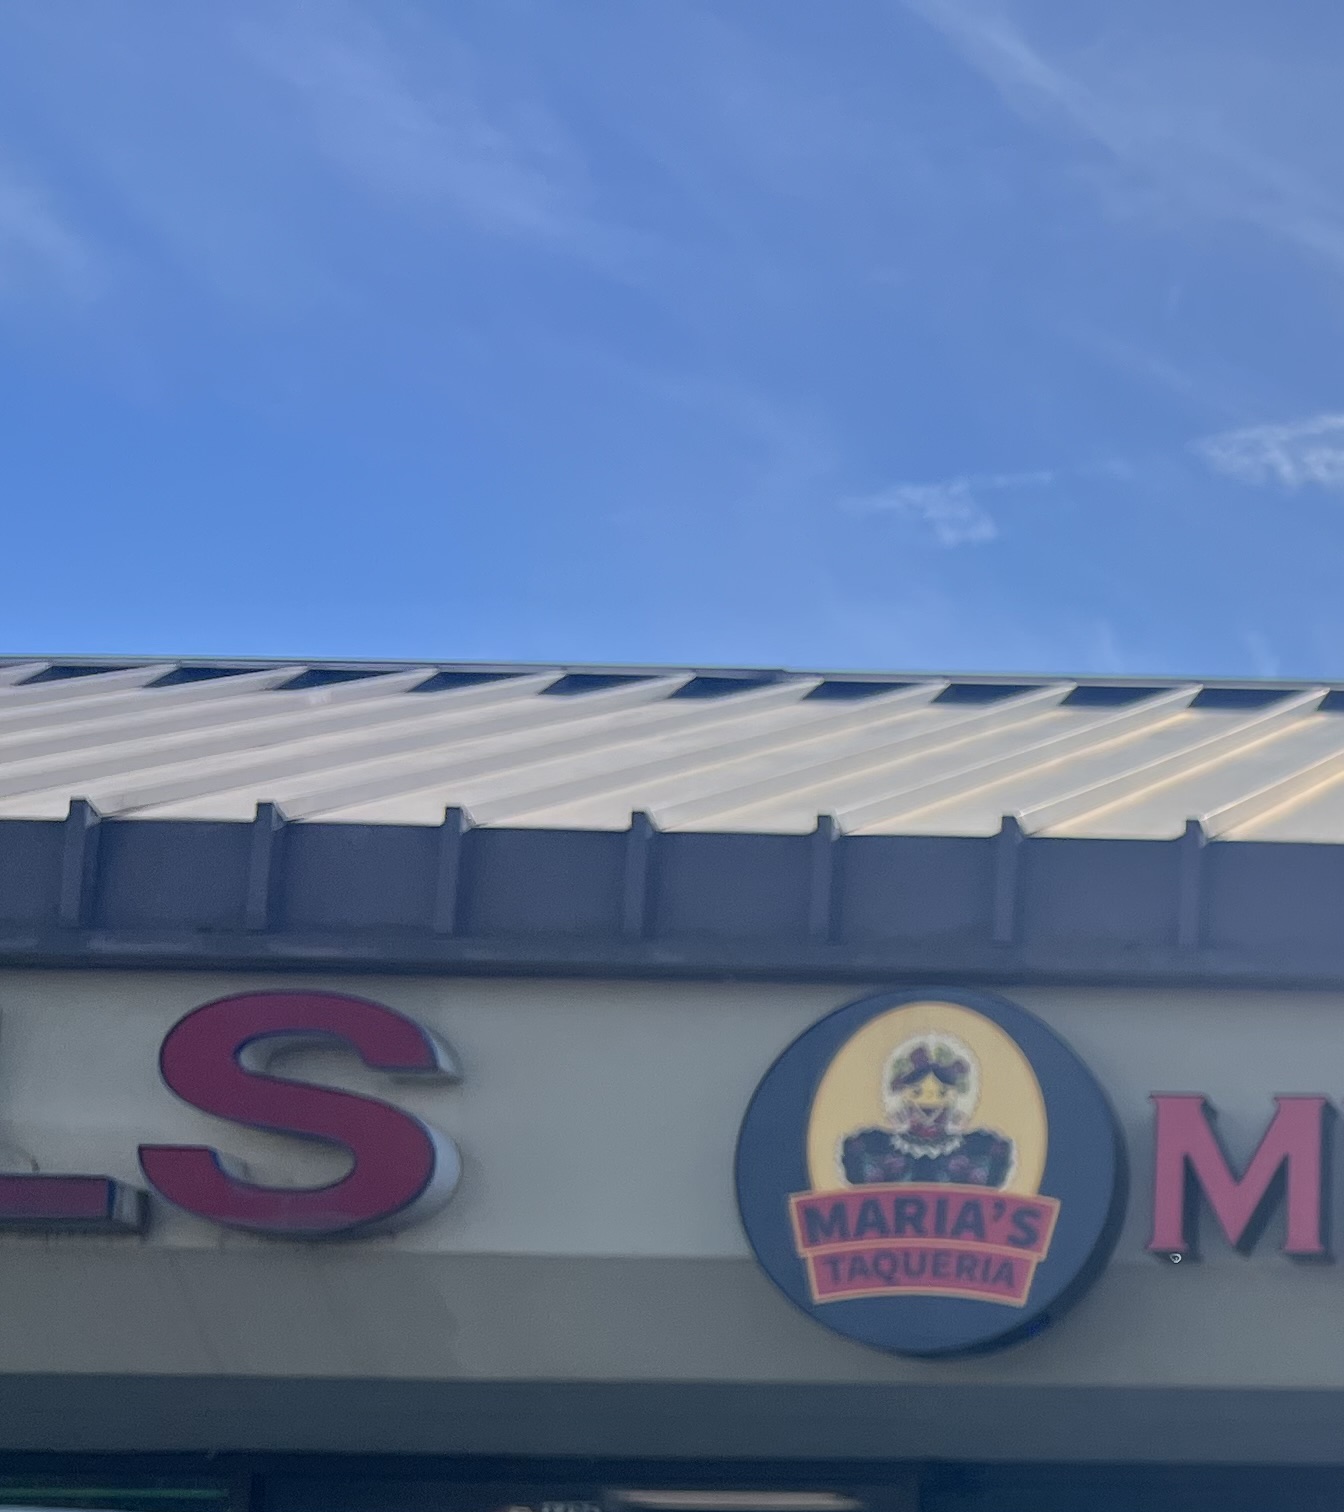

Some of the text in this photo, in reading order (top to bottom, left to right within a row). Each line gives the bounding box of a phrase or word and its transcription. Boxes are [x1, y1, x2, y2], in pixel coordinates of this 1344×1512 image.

[0, 990, 445, 1235] S
[803, 1198, 1042, 1246] MARIA'S
[823, 1251, 1016, 1288] TAQUERIA
